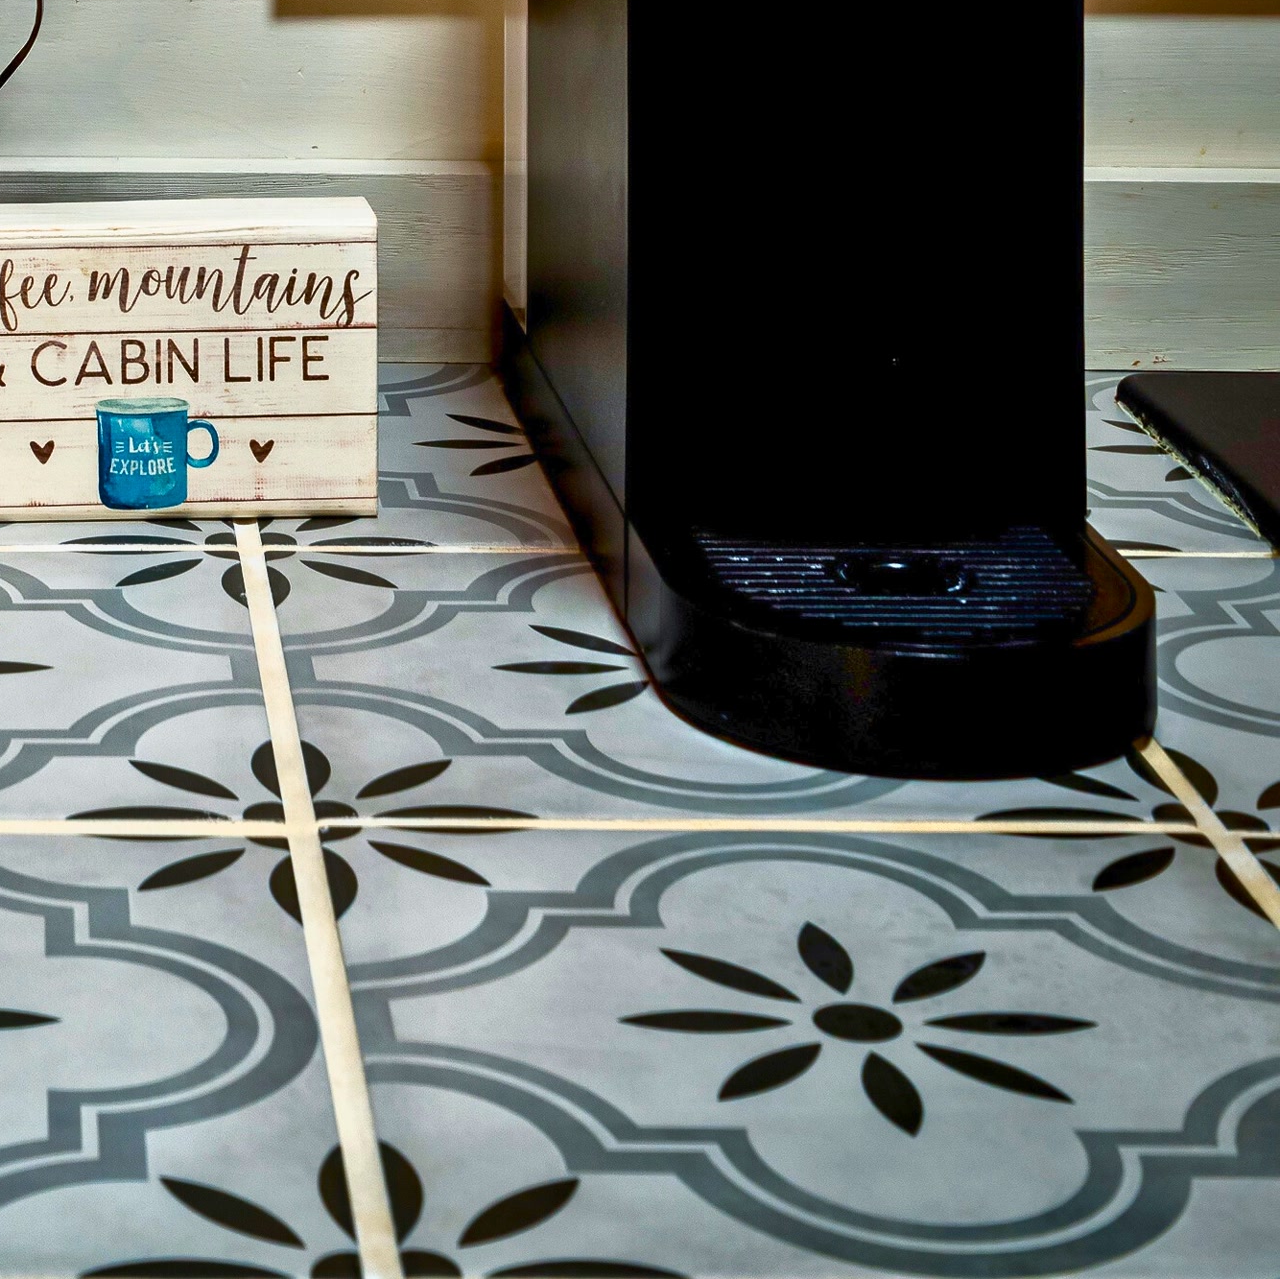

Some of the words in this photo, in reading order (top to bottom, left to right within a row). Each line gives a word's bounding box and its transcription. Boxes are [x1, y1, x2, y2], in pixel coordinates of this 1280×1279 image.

[88, 245, 373, 327] mountains
[30, 338, 200, 386] CABIN
[224, 336, 330, 383] LIFE
[129, 436, 158, 454] Let's
[109, 457, 176, 476] EXPLORE
